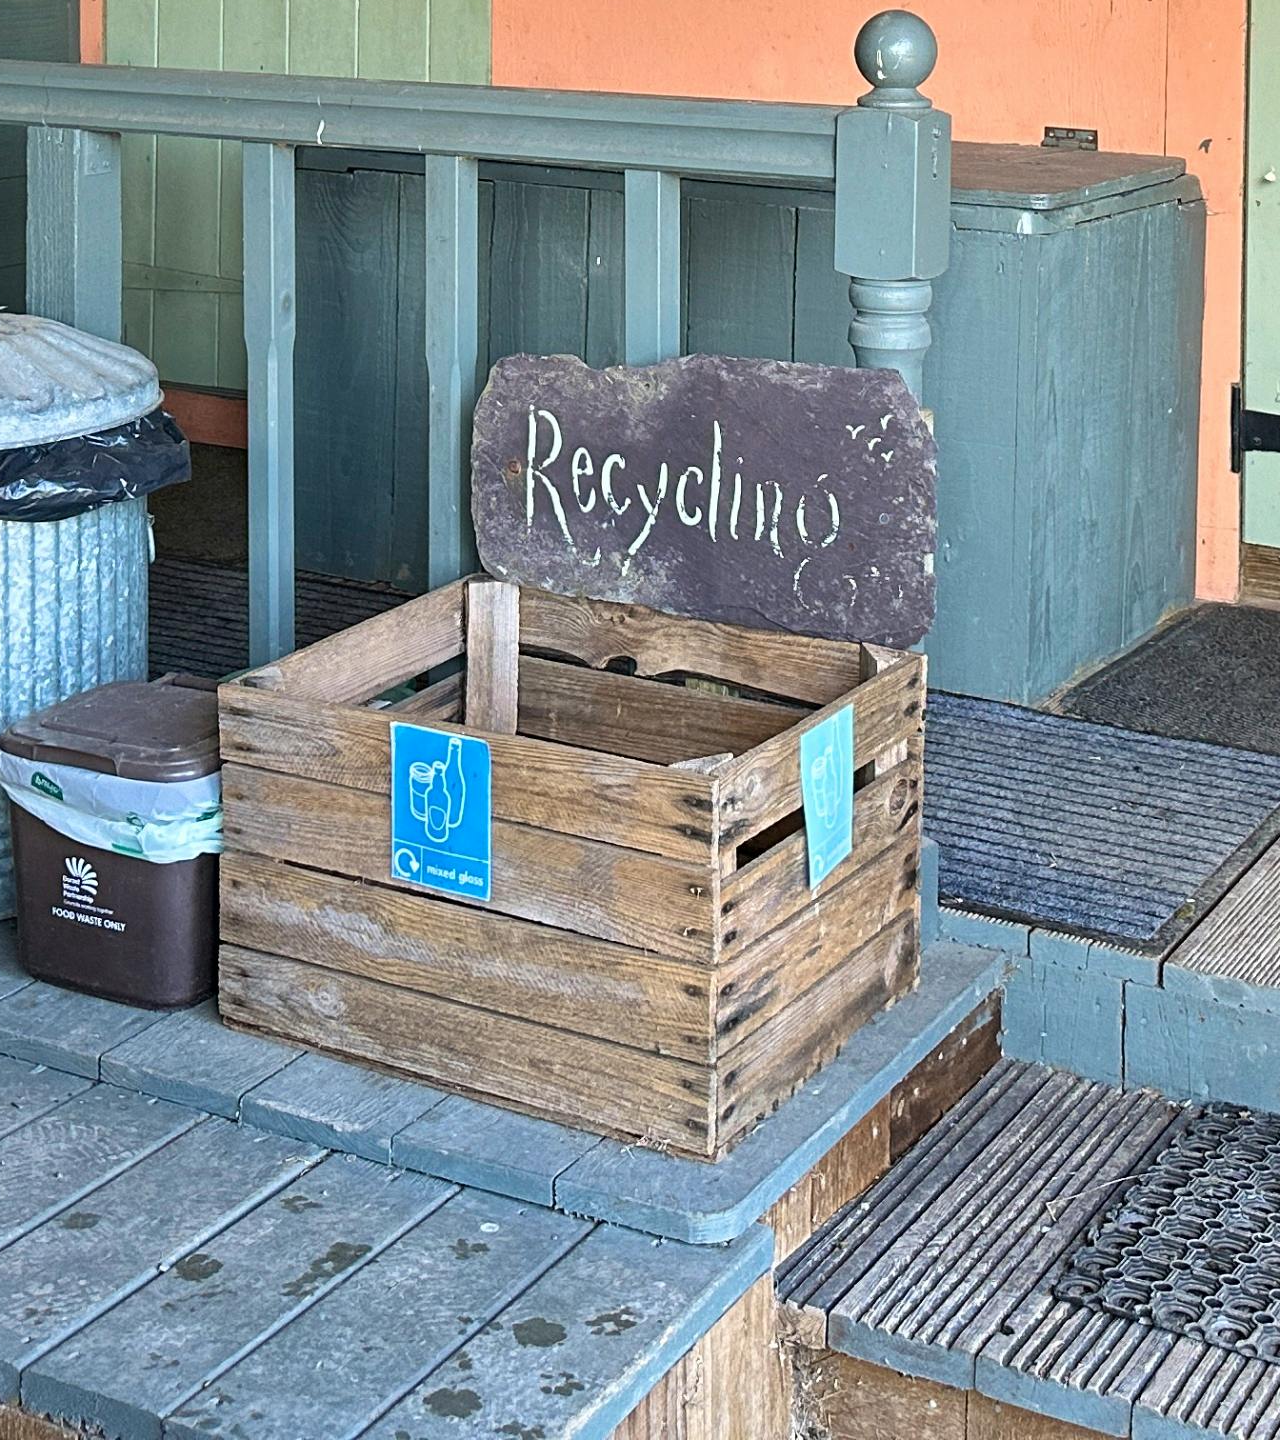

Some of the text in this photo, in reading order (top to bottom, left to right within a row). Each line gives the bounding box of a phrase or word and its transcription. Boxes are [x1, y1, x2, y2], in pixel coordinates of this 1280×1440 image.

[525, 403, 842, 614] Recycling
[426, 864, 484, 887] mixed glass
[51, 906, 126, 932] FOOD WASTE ONLY
